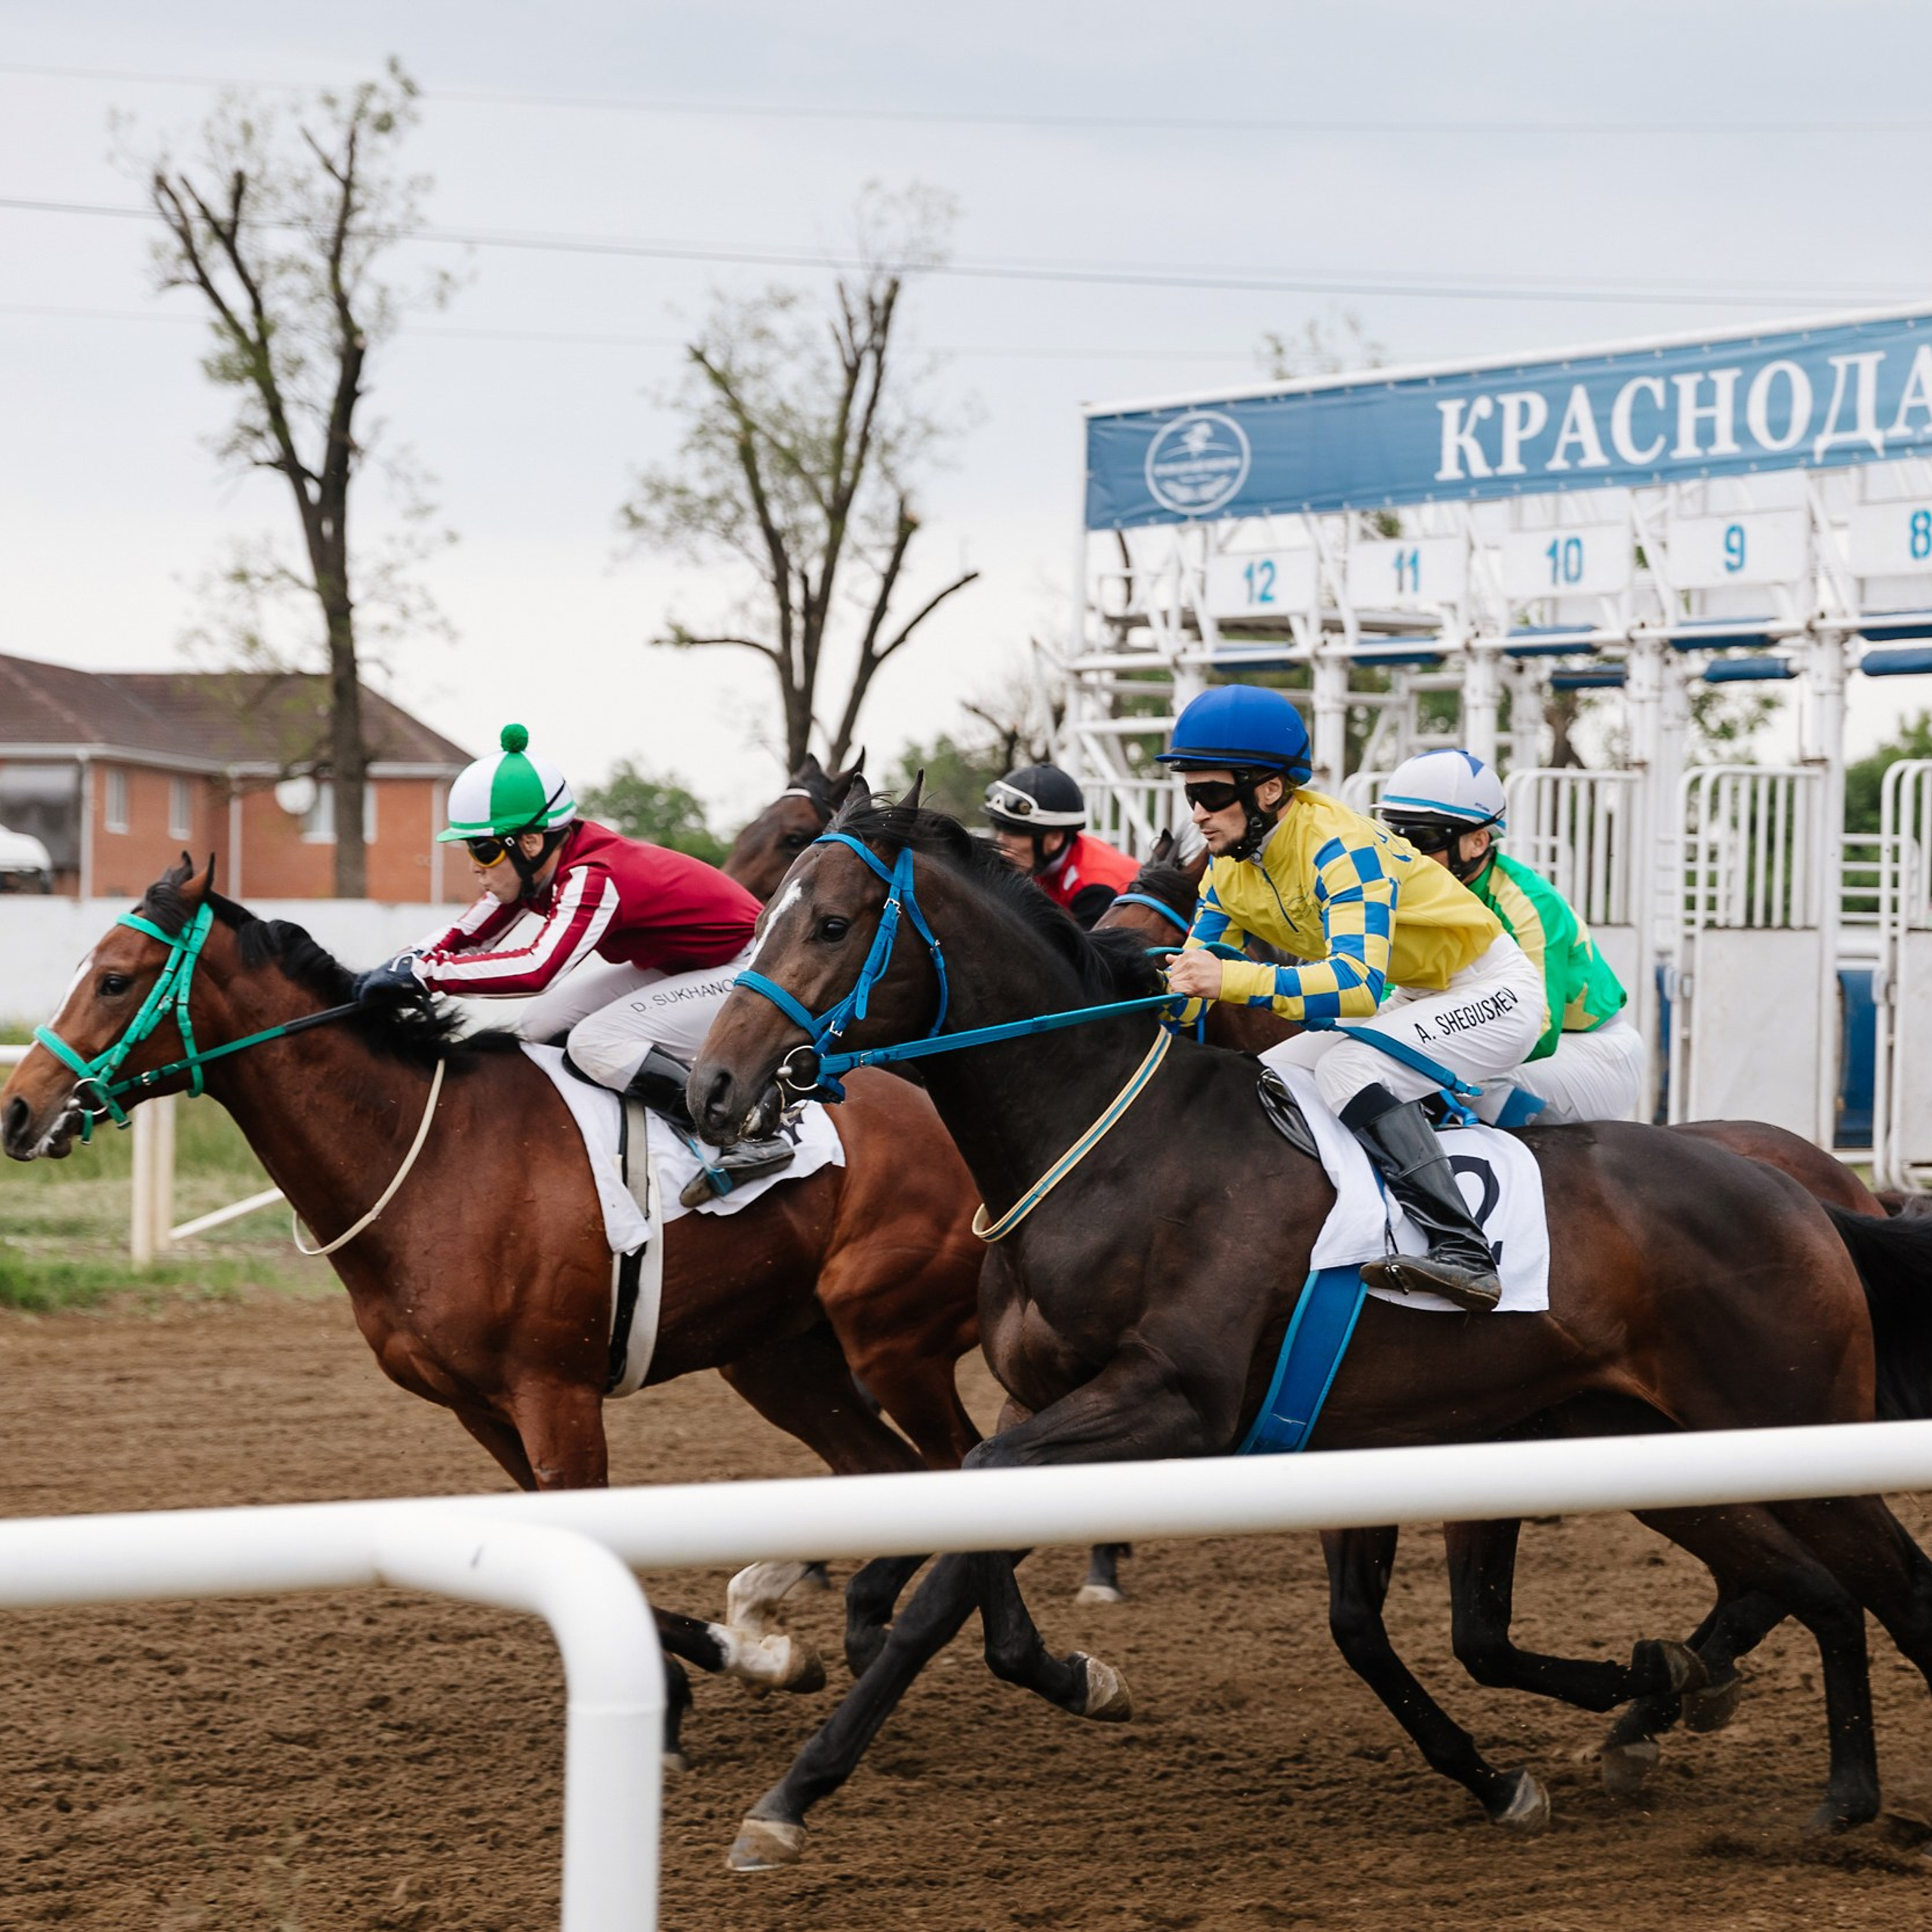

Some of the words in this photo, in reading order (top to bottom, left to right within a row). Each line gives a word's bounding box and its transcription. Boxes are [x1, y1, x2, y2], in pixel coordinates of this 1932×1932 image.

[1724, 524, 1746, 574] 9
[1911, 509, 1932, 560] 8
[1243, 558, 1277, 604] 12
[1393, 546, 1420, 594] 11
[1546, 536, 1583, 586] 10
[630, 1001, 653, 1013] D.
[653, 977, 736, 1006] SUKHANO
[1414, 1023, 1437, 1044] A.
